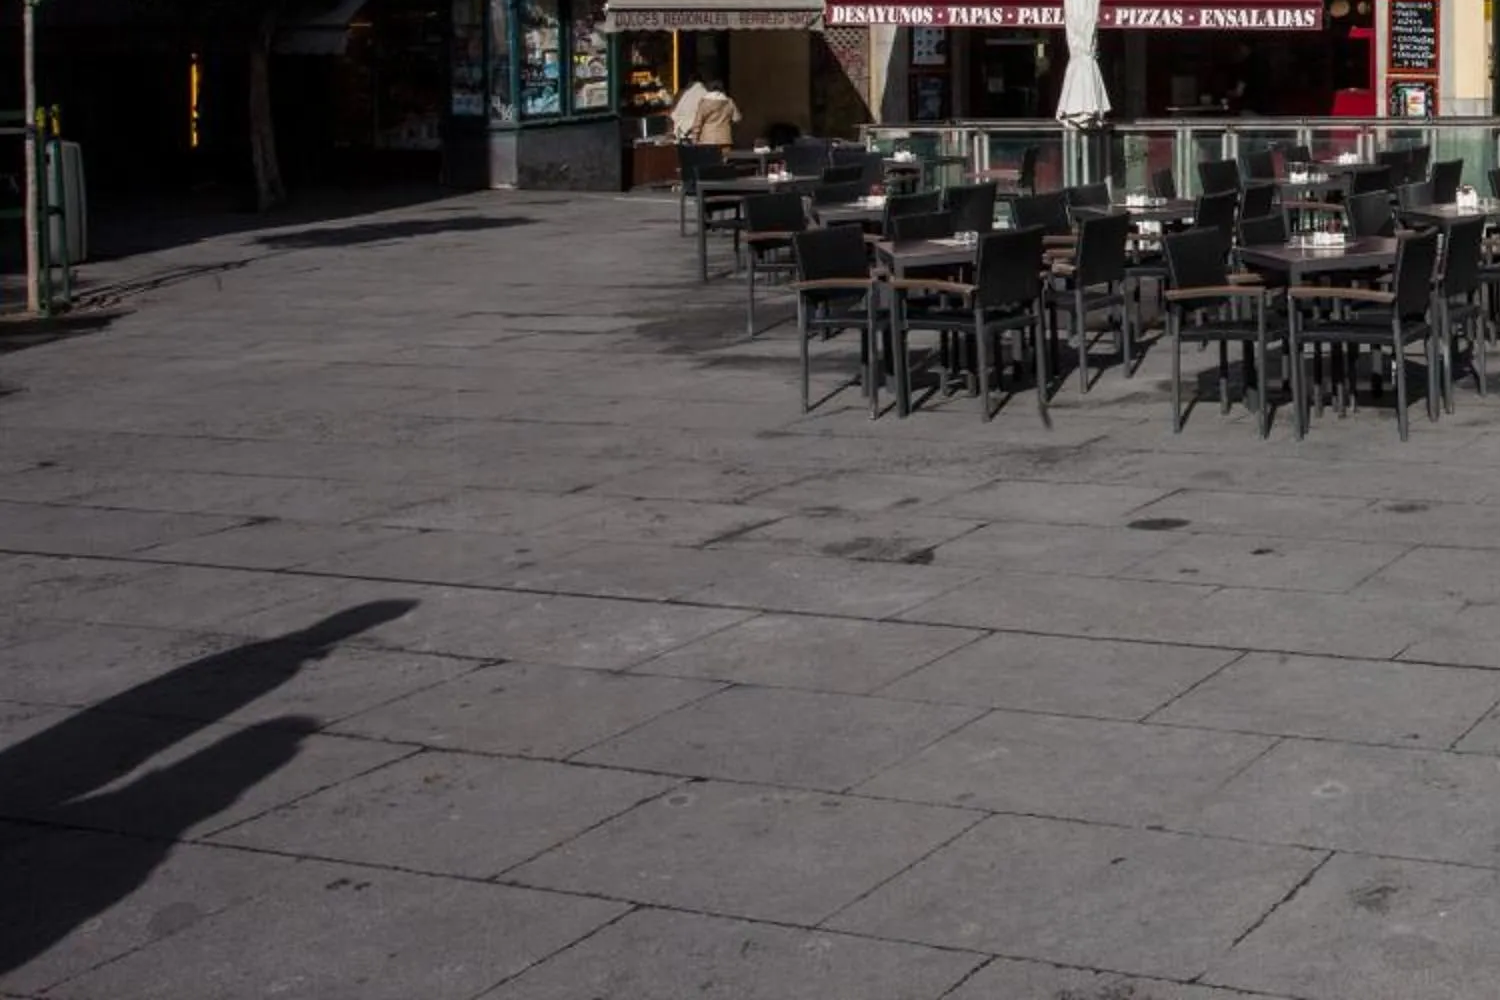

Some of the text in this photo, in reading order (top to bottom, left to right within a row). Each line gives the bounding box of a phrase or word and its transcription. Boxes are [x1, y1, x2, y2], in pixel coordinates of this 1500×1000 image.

[831, 5, 934, 24] DESAYUNOS
[947, 6, 1003, 24] TAPAS
[1016, 6, 1064, 25] PAEL
[1114, 7, 1184, 26] PIZZAS
[1198, 8, 1316, 28] ENSALADAS
